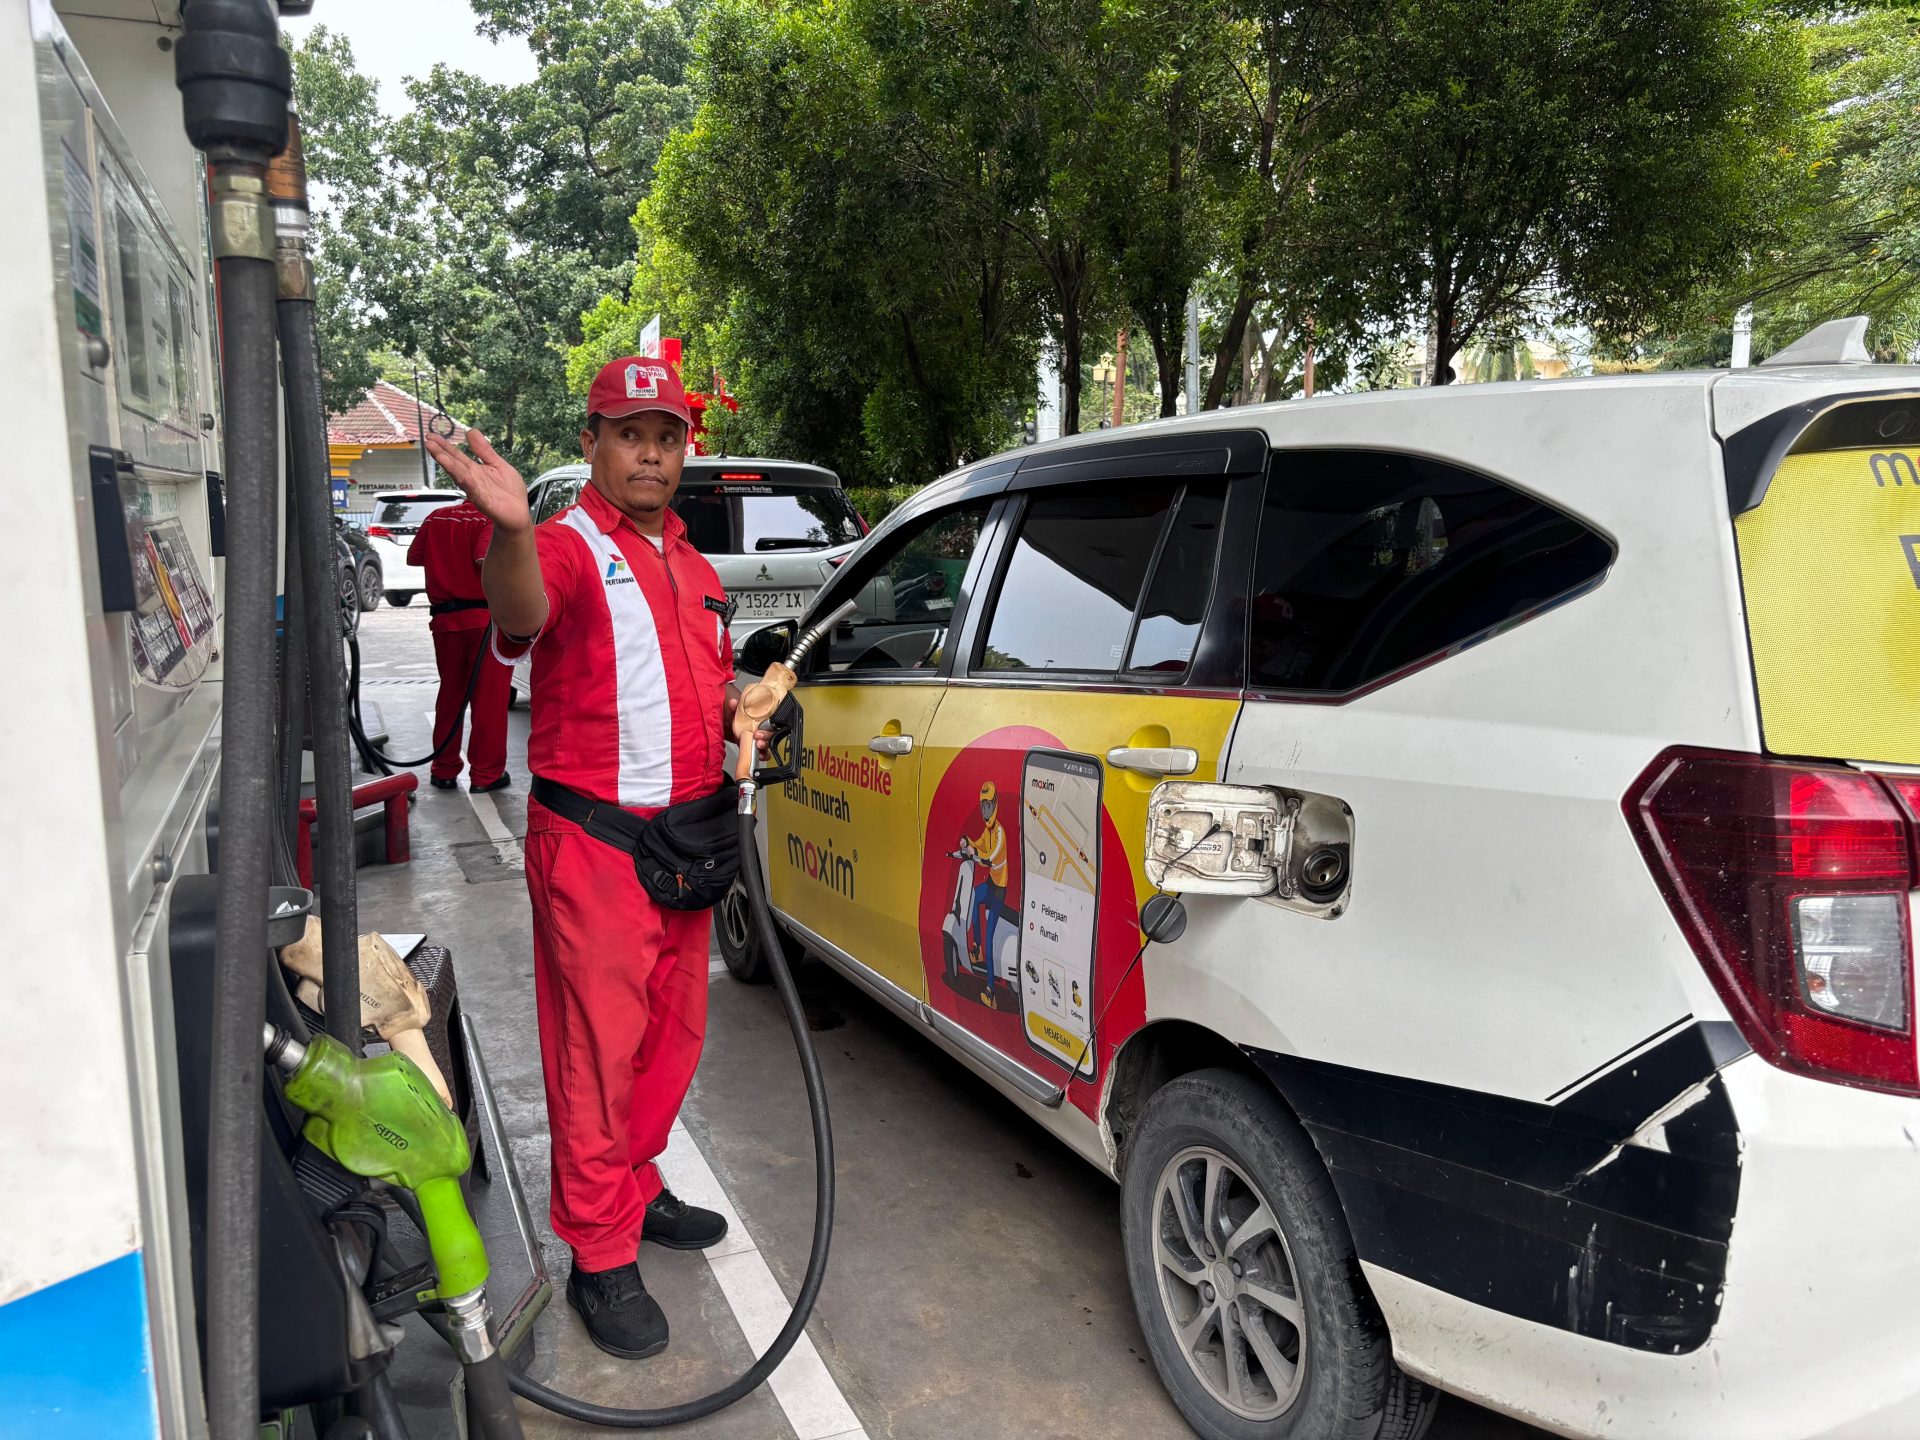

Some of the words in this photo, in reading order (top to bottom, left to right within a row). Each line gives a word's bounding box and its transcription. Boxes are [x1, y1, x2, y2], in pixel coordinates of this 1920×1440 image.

[1869, 452, 1920, 488] m
[605, 577, 635, 586] PERTAMINA
[745, 593, 779, 609] 1522
[786, 593, 802, 608] IX
[818, 744, 892, 796] MaximBike
[1031, 778, 1055, 792] maxim
[784, 777, 809, 807] lebih
[811, 790, 851, 823] murah
[1212, 844, 1222, 852] 92
[788, 832, 855, 901] maxim
[1041, 903, 1068, 924] Pekerjaan
[1039, 926, 1059, 943] Rumah
[1043, 1025, 1071, 1049] MEMESAN
[374, 1123, 409, 1150] SUNO
